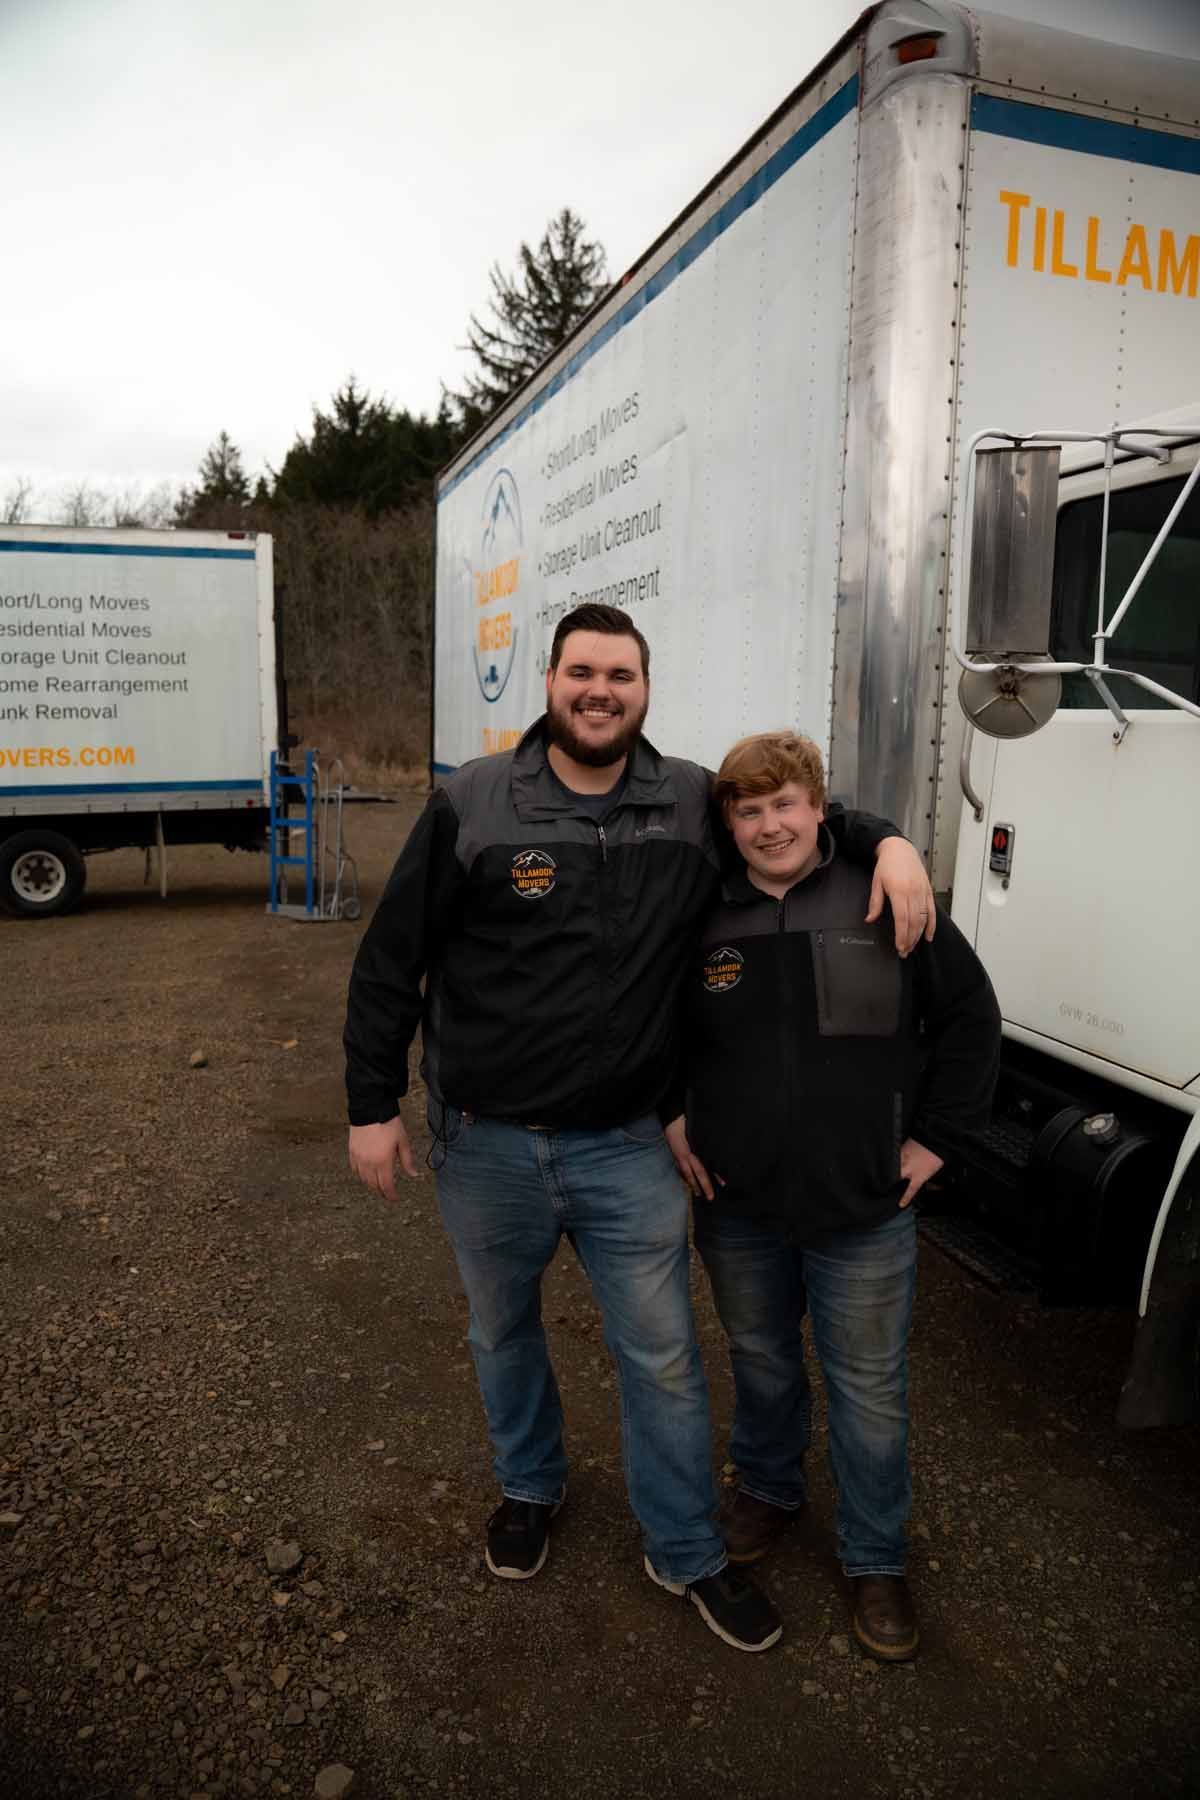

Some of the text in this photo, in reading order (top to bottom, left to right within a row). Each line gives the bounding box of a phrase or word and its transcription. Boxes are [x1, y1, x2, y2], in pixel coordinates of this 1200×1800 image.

[998, 189, 1200, 299] TILLAM
[599, 391, 639, 441] Moves
[598, 453, 638, 500] Moves
[604, 500, 661, 551] Cleanout
[90, 595, 150, 611] Moves
[92, 622, 152, 638] Moves
[62, 650, 99, 665] Unit
[105, 649, 187, 666] Cleanout
[46, 677, 189, 696] Rearrangement
[36, 704, 118, 720] Removal
[512, 868, 555, 879] TILLAMOOK
[518, 878, 550, 889] MOVERS
[708, 973, 737, 984] MOVERS
